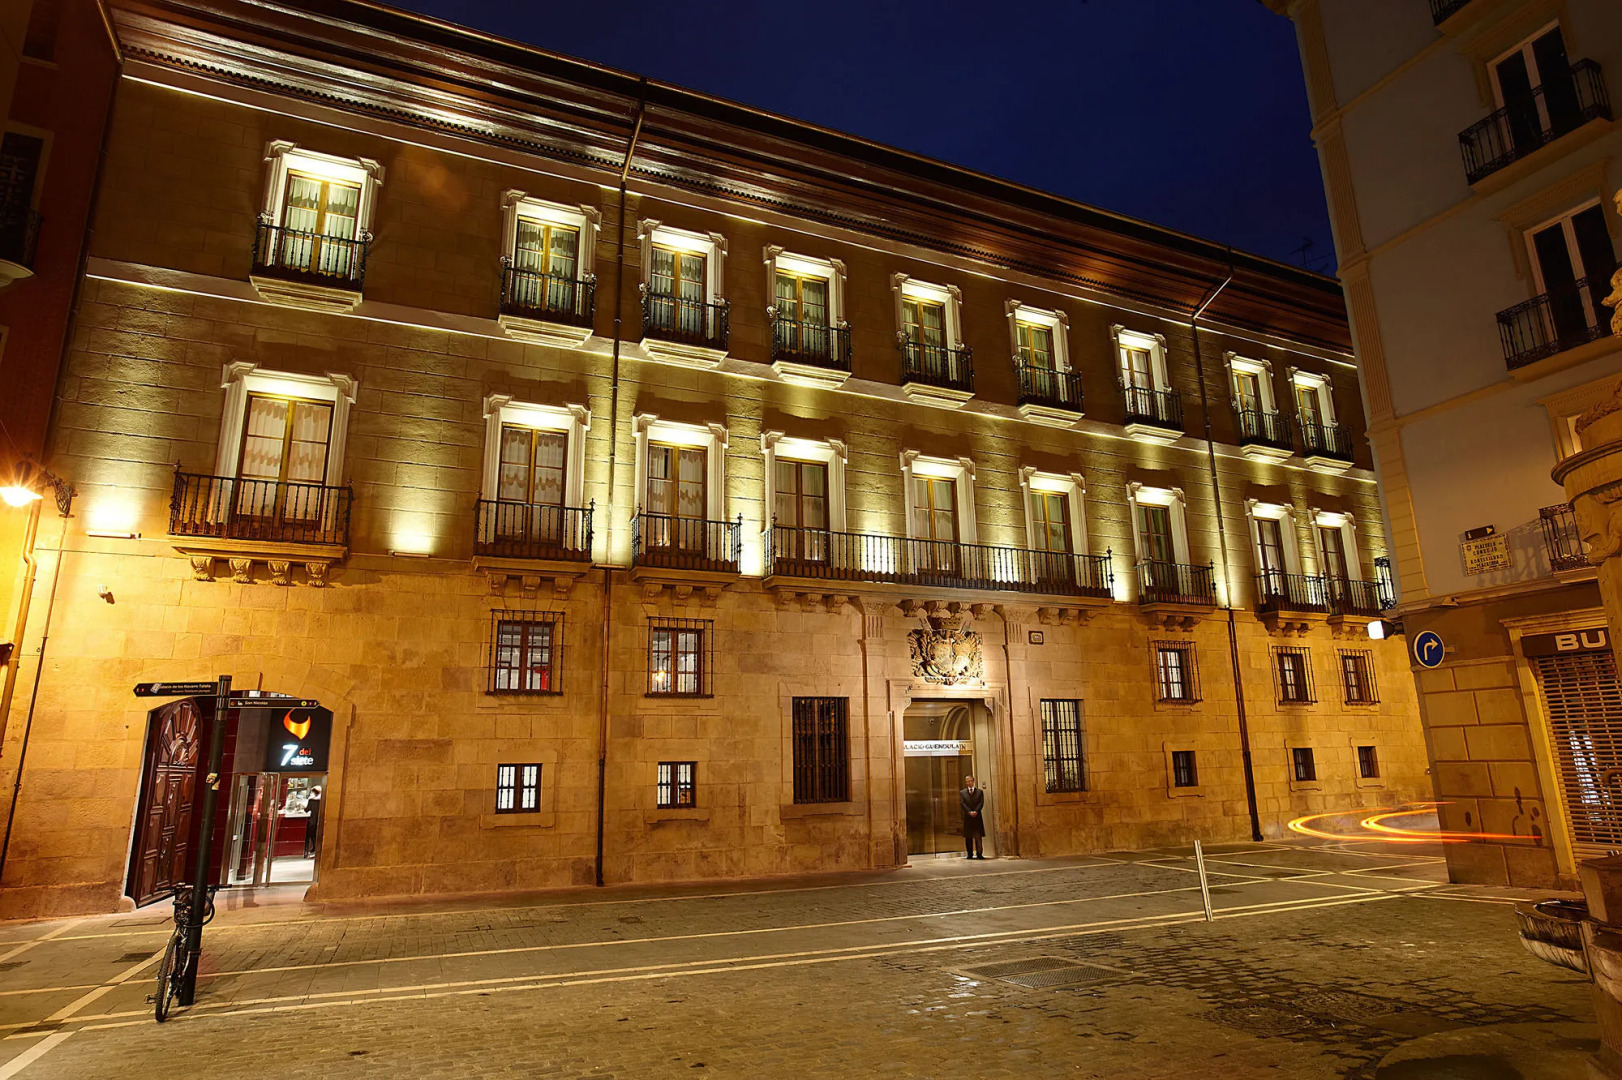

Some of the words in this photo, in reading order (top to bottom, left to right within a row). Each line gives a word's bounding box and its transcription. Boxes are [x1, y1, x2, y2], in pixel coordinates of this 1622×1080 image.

[1472, 547, 1498, 556] CONSEJO
[281, 744, 299, 766] 7
[299, 747, 312, 756] del
[290, 755, 314, 766] siete
